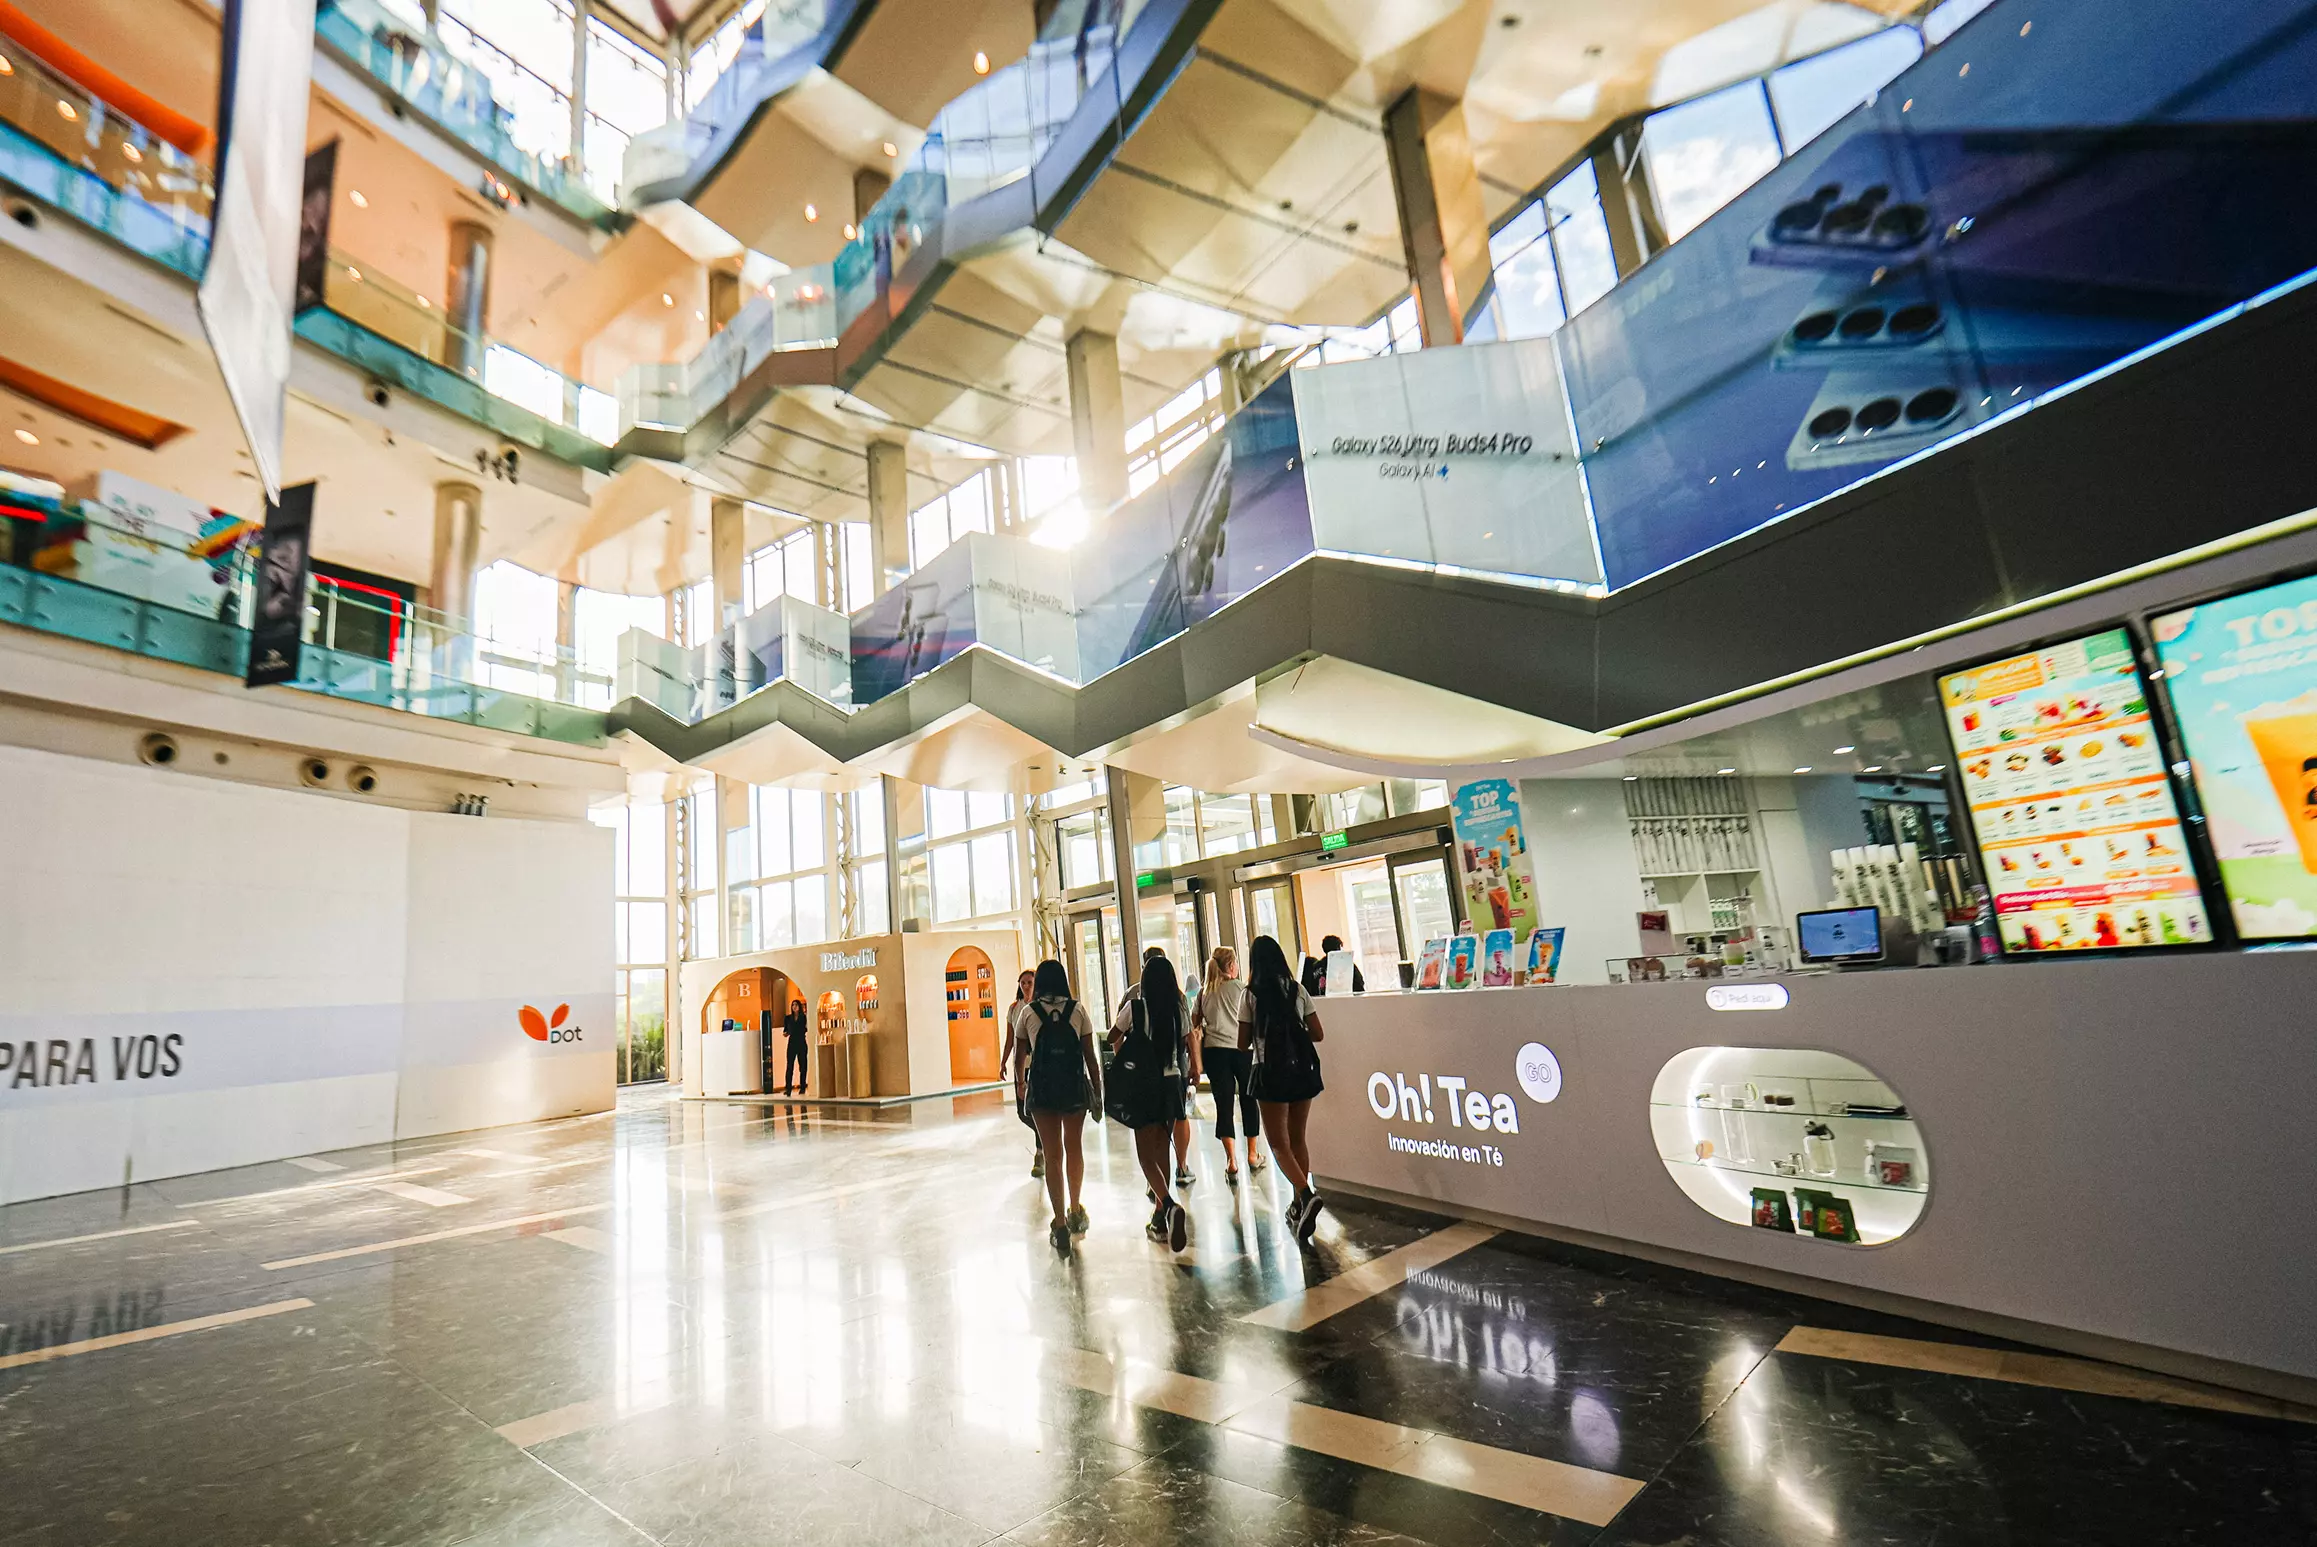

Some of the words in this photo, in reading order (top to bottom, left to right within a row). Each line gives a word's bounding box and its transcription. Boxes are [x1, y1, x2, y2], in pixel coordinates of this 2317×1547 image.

[1332, 436, 1377, 457] Galaxy
[1379, 434, 1402, 456] S26
[1446, 432, 1499, 456] Buds4
[1501, 433, 1533, 455] Pro
[1379, 463, 1421, 482] Galaxy
[1422, 464, 1436, 478] AI
[1471, 790, 1499, 810] TOP
[1323, 833, 1346, 847] SALIDA
[738, 983, 751, 998] B
[0, 1038, 96, 1089] PARA
[112, 1033, 183, 1081] VOS
[1524, 1062, 1552, 1084] GO
[1367, 1071, 1435, 1124] Oh!
[1436, 1075, 1520, 1135] Tea
[1387, 1132, 1460, 1162] Innovación
[1461, 1146, 1481, 1164] en
[1482, 1145, 1504, 1168] Té
